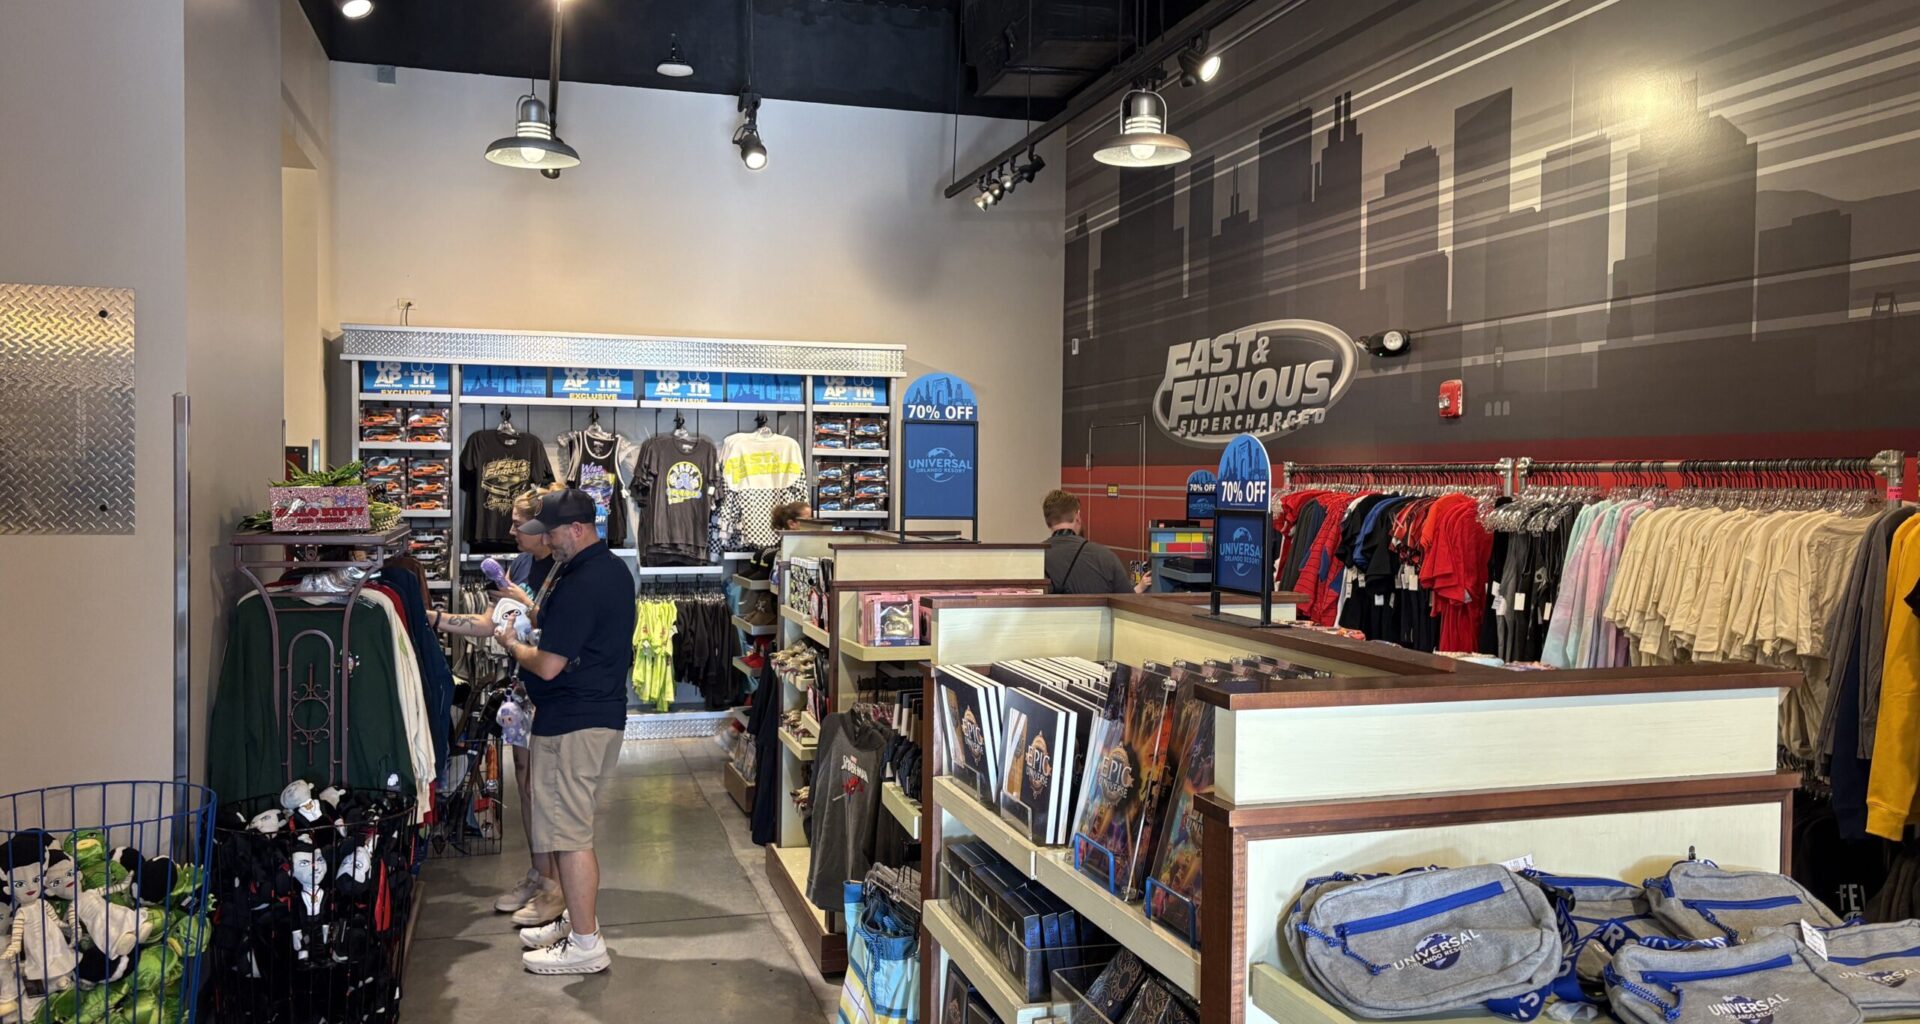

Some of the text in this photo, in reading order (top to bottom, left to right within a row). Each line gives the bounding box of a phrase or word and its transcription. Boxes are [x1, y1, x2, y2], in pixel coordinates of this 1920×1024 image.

[1164, 329, 1270, 391] FAST &
[375, 371, 402, 384] AP
[411, 372, 434, 385] TM
[562, 374, 589, 389] AP
[598, 375, 620, 389] TM
[656, 381, 680, 393] AP
[688, 381, 710, 394] TM
[569, 392, 617, 400] EXCLUSIVE
[824, 386, 847, 397] AP
[854, 386, 875, 399] TM
[1169, 360, 1334, 428] FURIOUS
[908, 405, 974, 420] 70% OFF
[1179, 408, 1326, 434] SUPERCHARGED
[908, 458, 973, 470] UNIVERSAL
[1222, 480, 1267, 503] 70% OFF
[322, 507, 364, 517] KITTY
[1025, 744, 1050, 777] EPIC
[1100, 755, 1132, 788] EPIC
[1101, 777, 1129, 799] UNIVERSE
[1394, 929, 1480, 971] UNIVERSAL
[1407, 942, 1474, 970] ORLANDO RESORT
[1708, 992, 1790, 1016] UNIVERSAL
